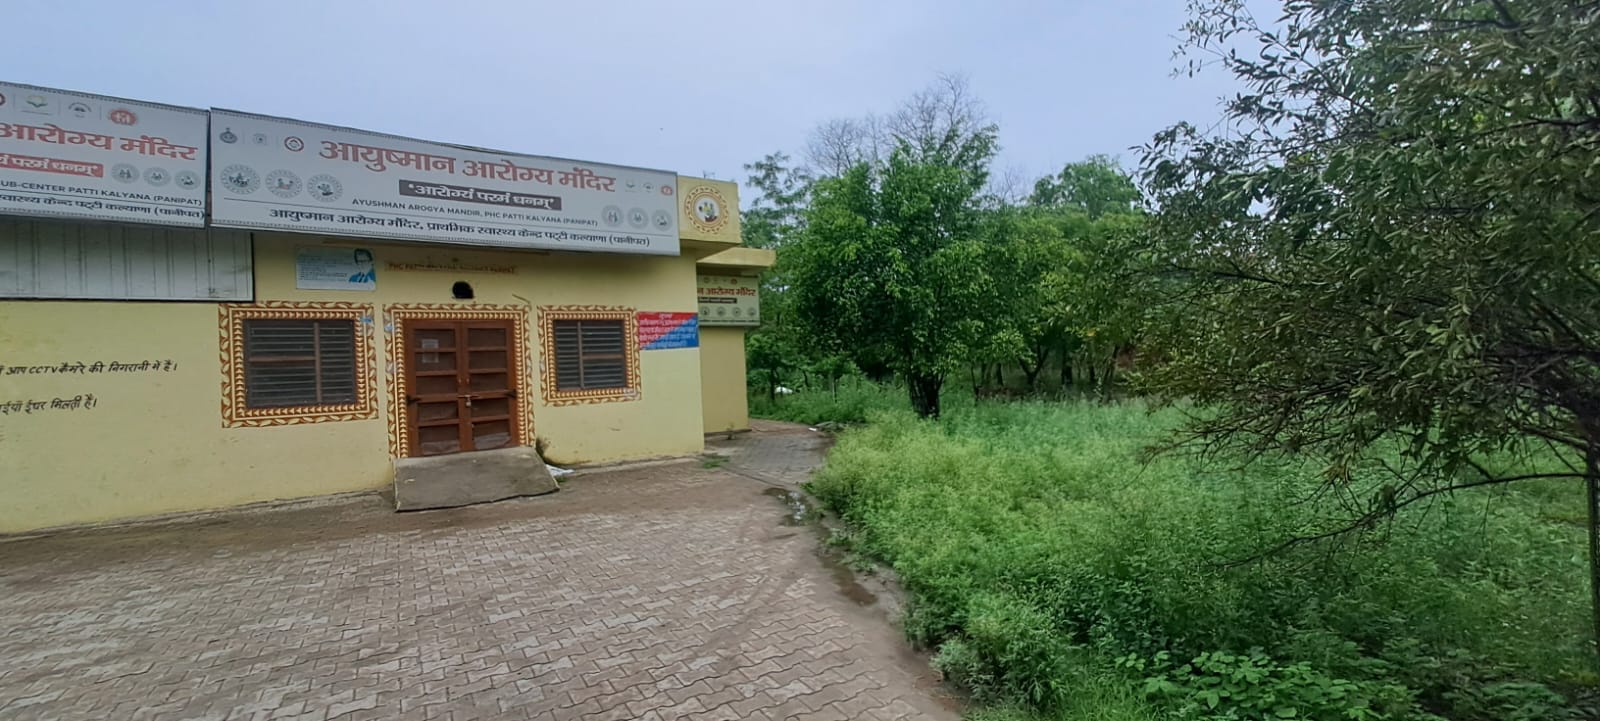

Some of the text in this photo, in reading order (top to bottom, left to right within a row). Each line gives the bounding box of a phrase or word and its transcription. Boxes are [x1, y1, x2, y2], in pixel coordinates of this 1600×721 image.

[119, 134, 198, 160] मंदिर
[319, 140, 616, 192] आयुष्मान आरोग्य मंदिर
[0, 181, 202, 206] UB-CENTER PATTI KALYANA (PANIPAT)
[352, 198, 406, 209] AYUSHMAN
[408, 203, 445, 213] AROGYA
[526, 214, 562, 223] KALYANA
[563, 217, 598, 227] (PANIPAT)
[269, 208, 334, 222] आयुष्मान
[337, 213, 385, 227] आरोग्य
[427, 221, 475, 234] प्राथमिक
[477, 225, 516, 237] स्वास्थ्य
[518, 228, 543, 239] केन्द्र
[609, 234, 650, 247] (पानीपत)
[6, 366, 27, 375] आप
[29, 366, 58, 374] CCTV
[89, 360, 106, 373] की
[108, 360, 151, 373] निगरानी
[50, 395, 82, 411] मिलती
